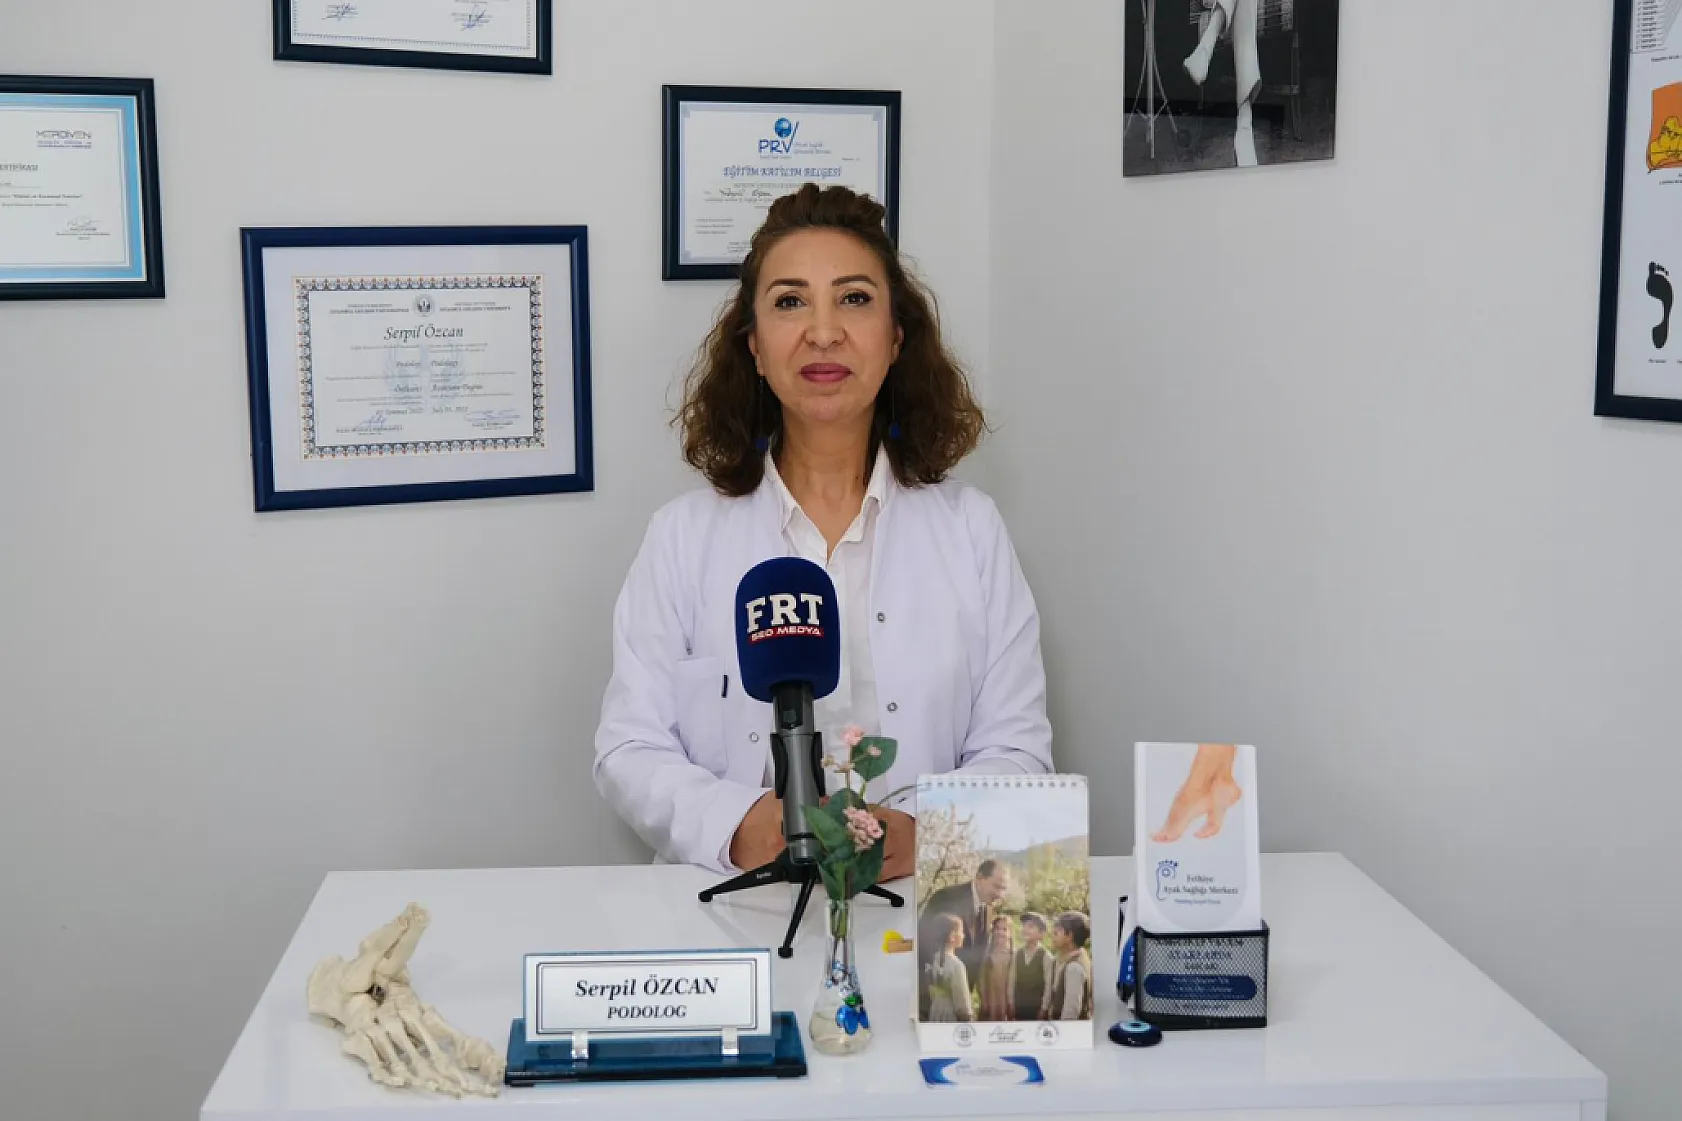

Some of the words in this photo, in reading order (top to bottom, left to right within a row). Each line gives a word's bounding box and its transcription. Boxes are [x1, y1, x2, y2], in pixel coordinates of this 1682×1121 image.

[384, 325, 424, 343] Serpil
[424, 323, 464, 338] Özcan
[745, 593, 823, 634] FRT
[777, 626, 821, 636] MEDYA
[575, 979, 637, 1001] Serpil
[643, 973, 719, 996] ÖZCAN
[607, 1004, 687, 1019] PODOLOG
